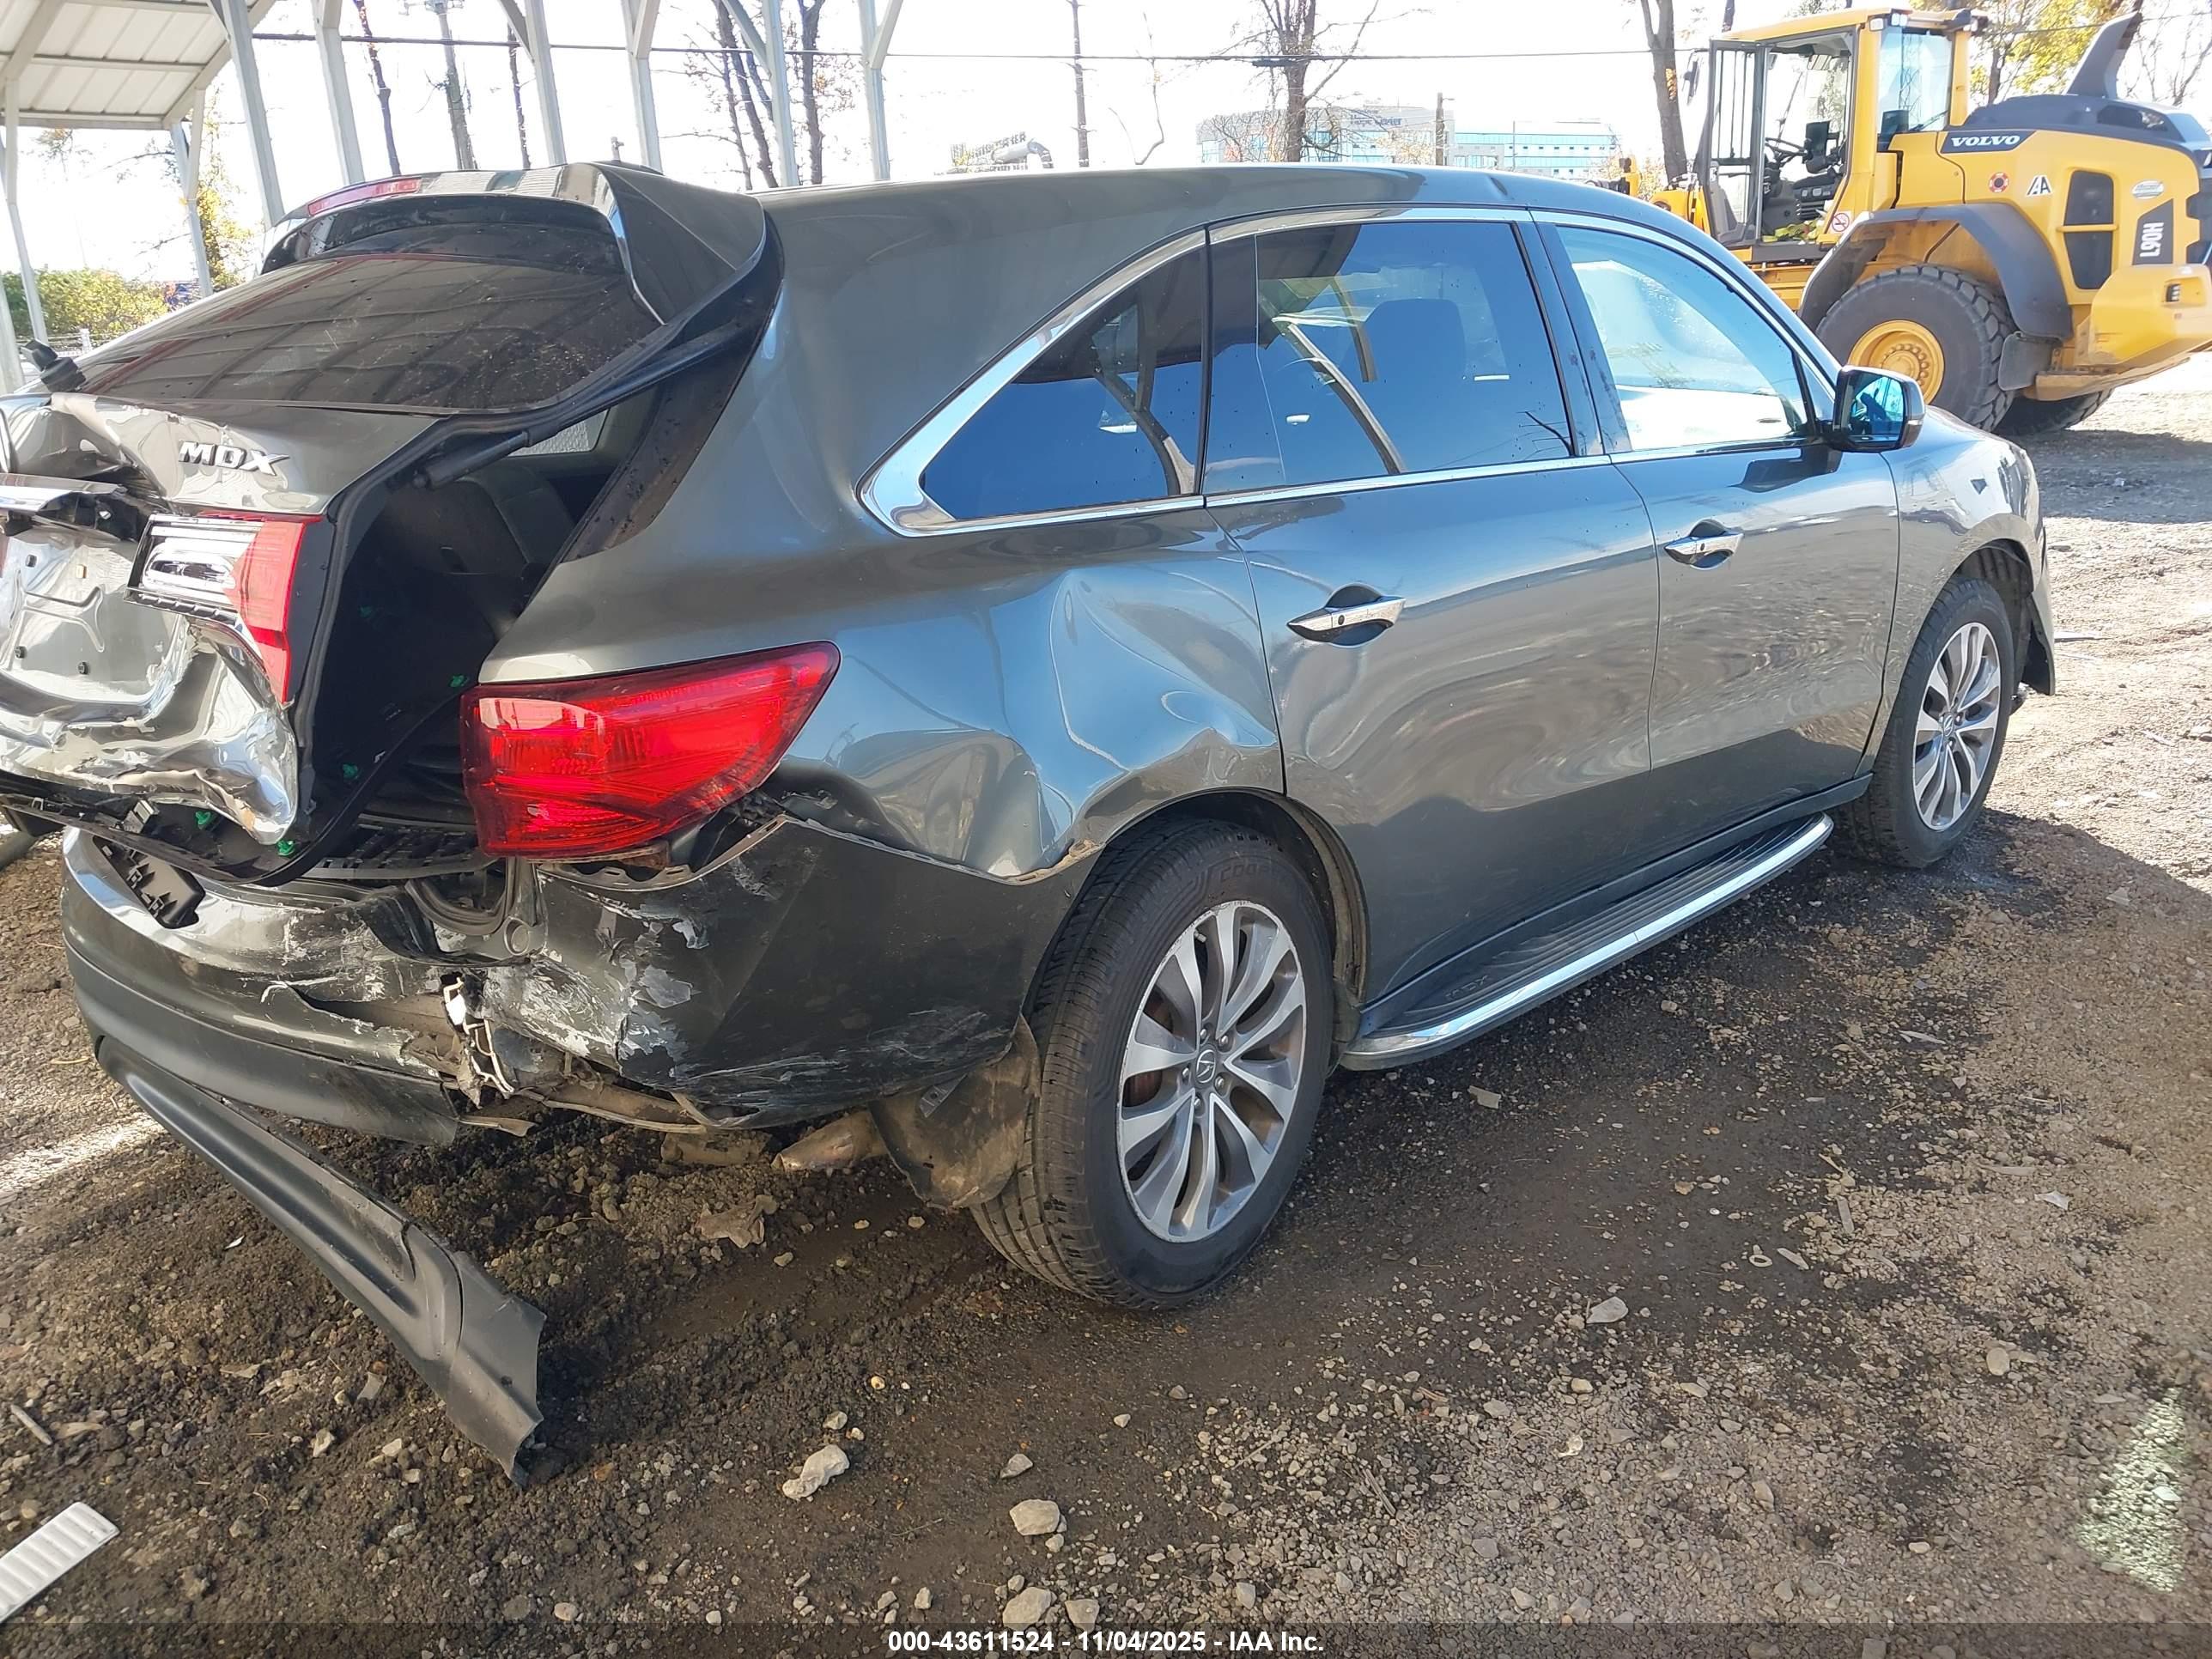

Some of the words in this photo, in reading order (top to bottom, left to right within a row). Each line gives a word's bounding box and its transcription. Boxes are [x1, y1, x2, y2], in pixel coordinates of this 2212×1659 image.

[1951, 135, 2021, 147] VOLVO
[2139, 222, 2164, 258] L90H
[179, 441, 290, 477] MDX
